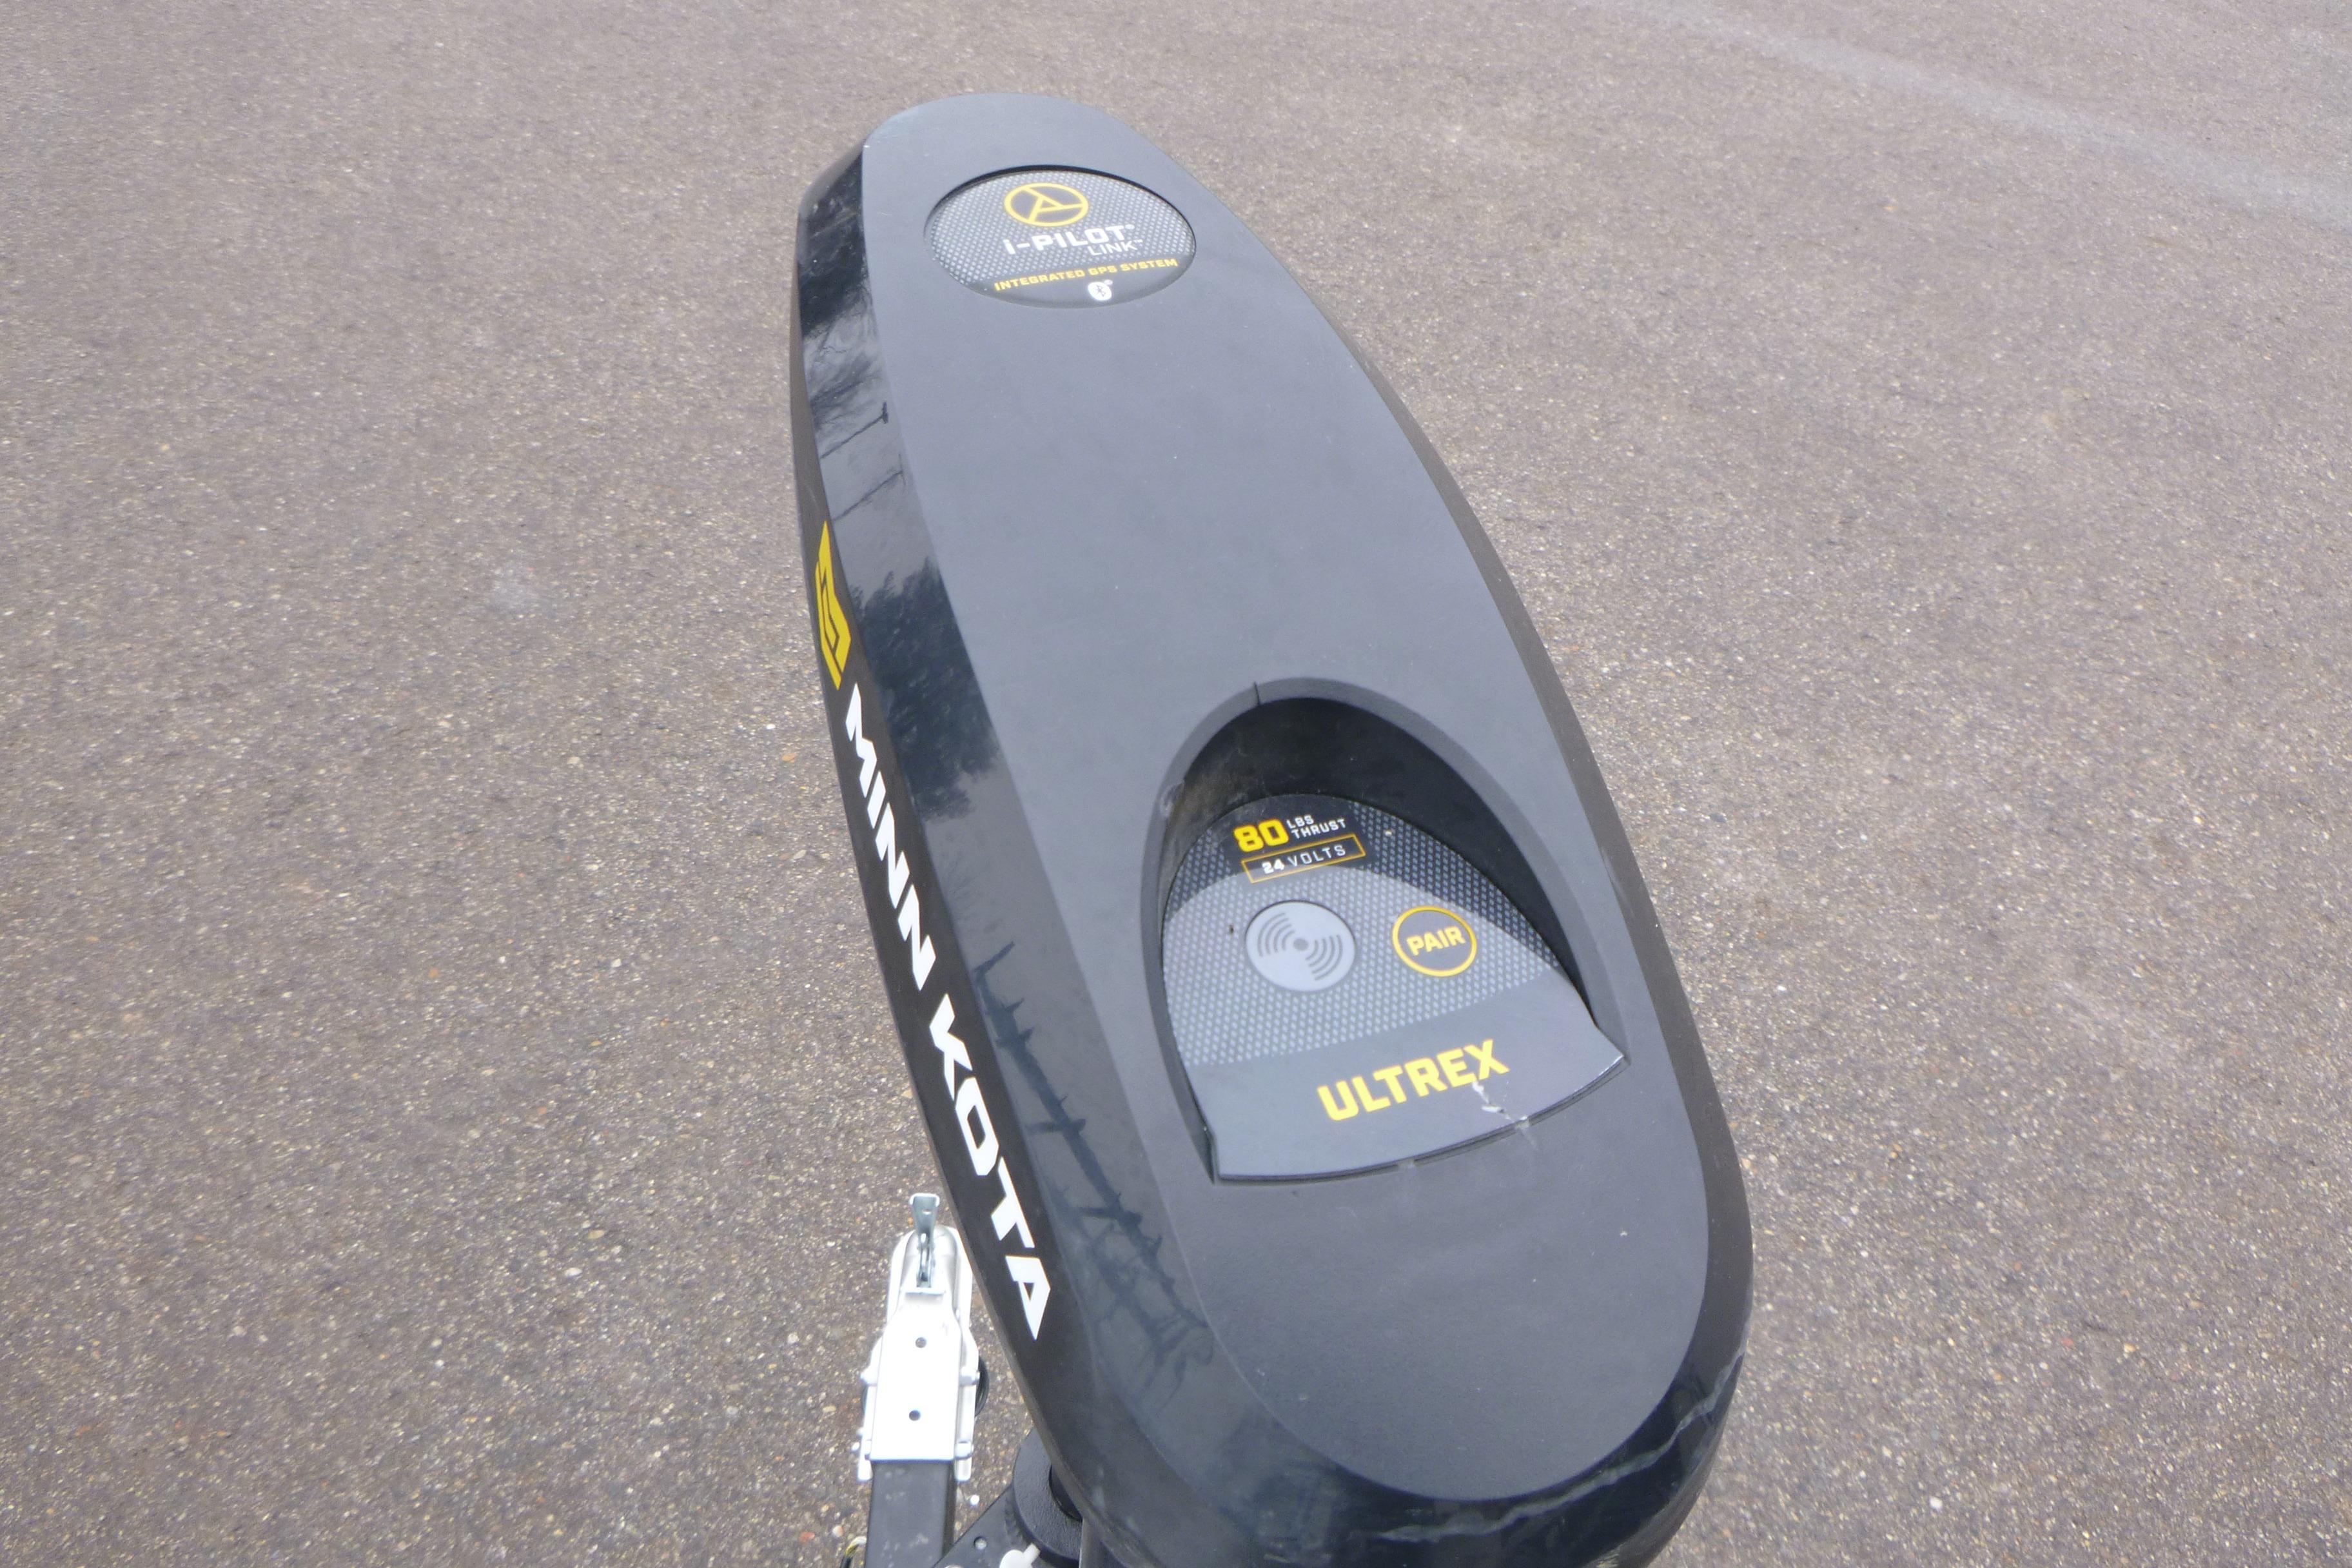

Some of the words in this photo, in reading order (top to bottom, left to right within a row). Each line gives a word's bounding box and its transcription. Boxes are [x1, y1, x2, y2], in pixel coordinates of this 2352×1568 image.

[1003, 225, 1126, 255] i-PILOT
[994, 269, 1086, 291] INTEGRATED
[1088, 264, 1118, 277] GPS
[1122, 258, 1179, 273] SYSTEM
[1233, 818, 1289, 852] 80
[1286, 814, 1315, 829] LBS
[1291, 818, 1346, 839] THRUST
[1262, 858, 1285, 874] 24
[1288, 844, 1346, 867] VOLTS
[1406, 926, 1465, 956] PAIR
[845, 681, 937, 990] MINN
[929, 993, 1051, 1340] KOTA
[1317, 1039, 1510, 1121] ULTREX
